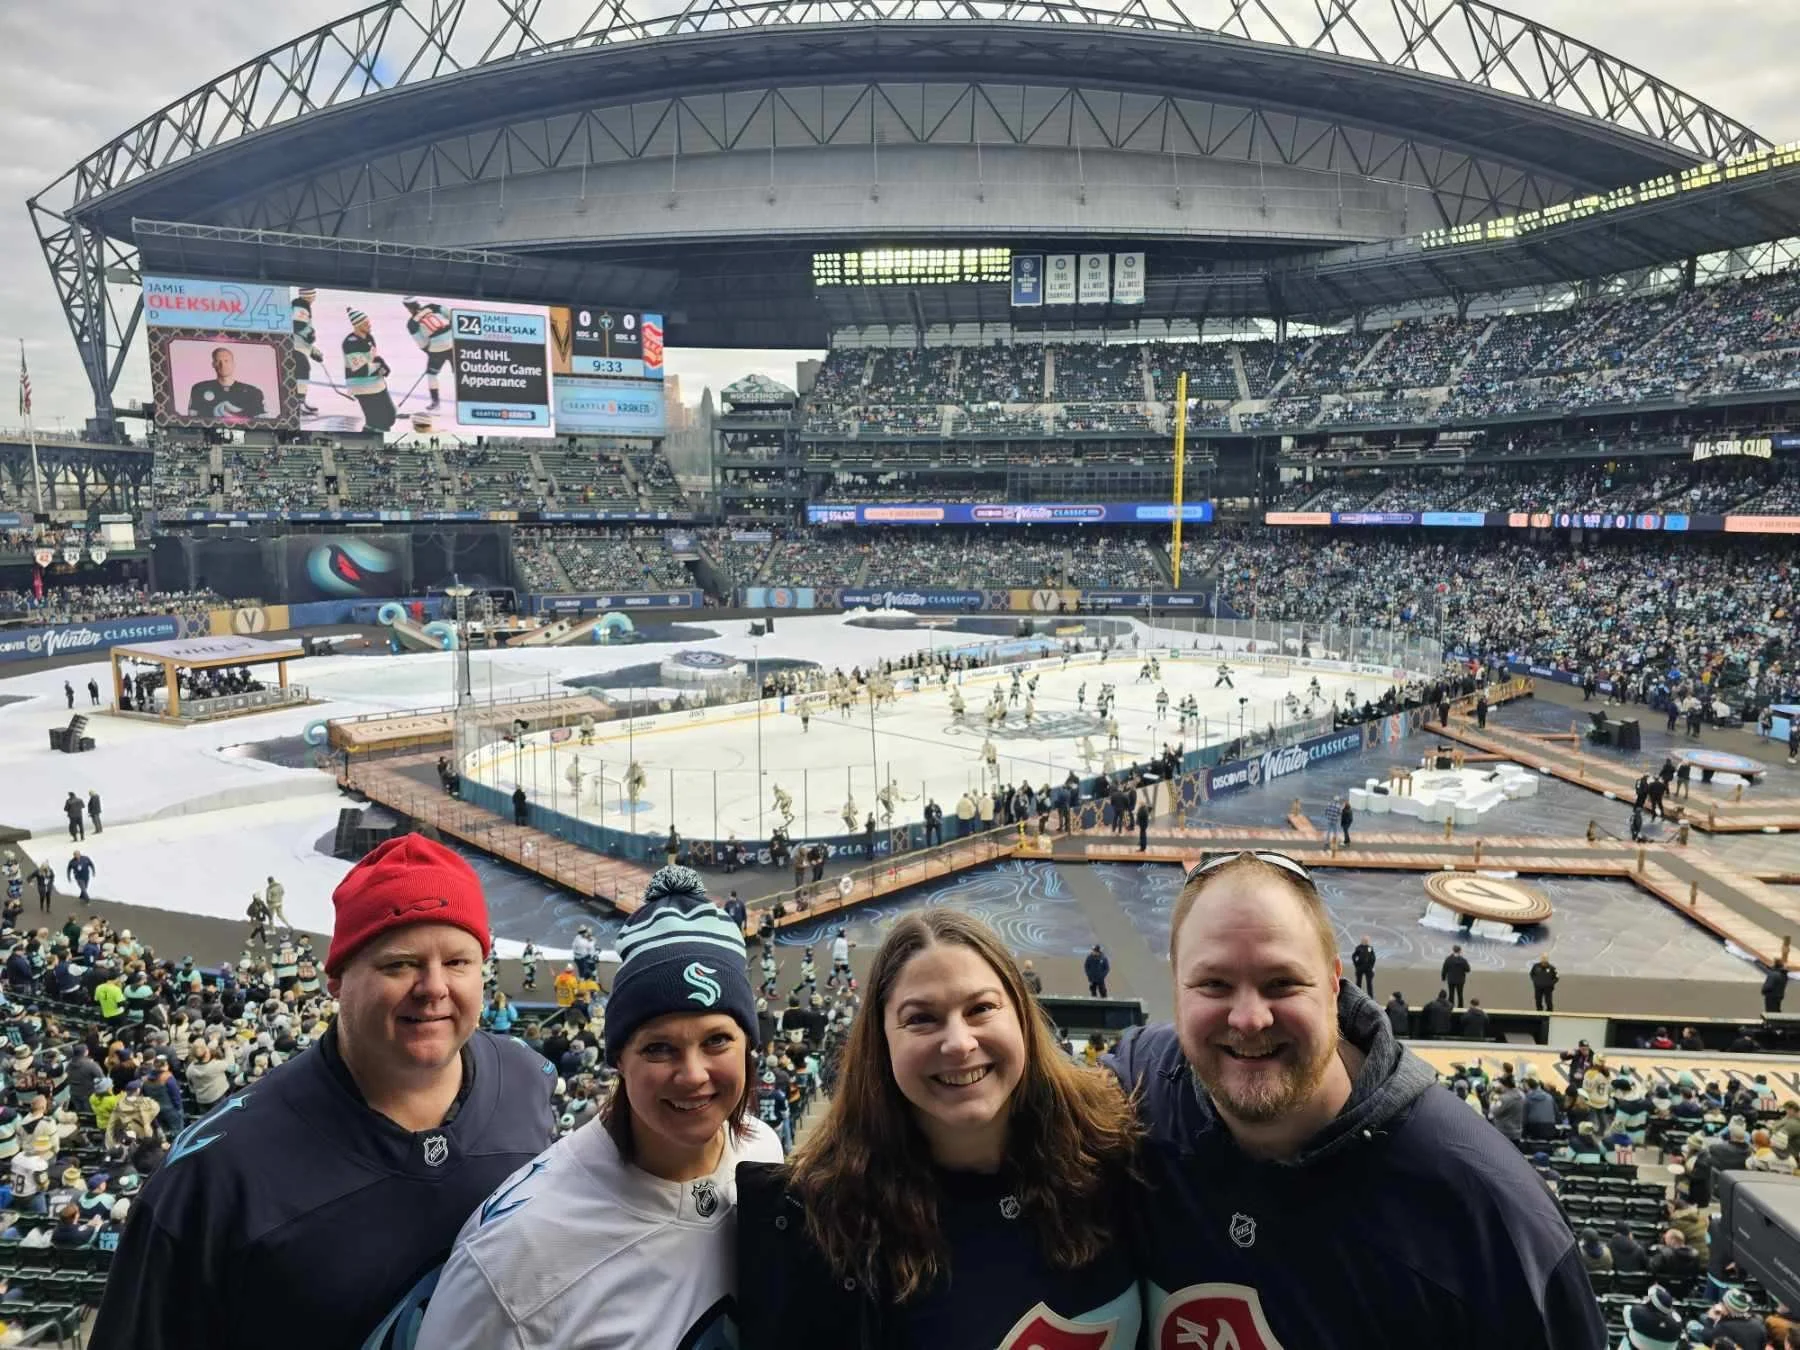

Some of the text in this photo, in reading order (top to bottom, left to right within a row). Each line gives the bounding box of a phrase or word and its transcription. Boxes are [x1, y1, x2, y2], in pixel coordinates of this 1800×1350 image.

[149, 283, 185, 294] JAMIE
[149, 295, 242, 313] OLEKSIAK
[220, 284, 285, 330] 24
[459, 316, 480, 335] 24
[579, 311, 635, 330] 0 0
[483, 324, 537, 336] OLEKSIAK
[460, 348, 511, 362] 2nd NHL
[460, 361, 542, 376] Outdoor Game
[593, 360, 622, 373] 9:33
[461, 374, 527, 388] Appearance
[1743, 439, 1772, 458] CLUB
[928, 596, 967, 604] CLASSIC
[43, 628, 102, 656] Winter
[104, 625, 156, 640] CLASSIC
[1212, 769, 1248, 790] DISCOVER
[1261, 745, 1309, 781] Winter
[1309, 736, 1348, 760] CLASSIC
